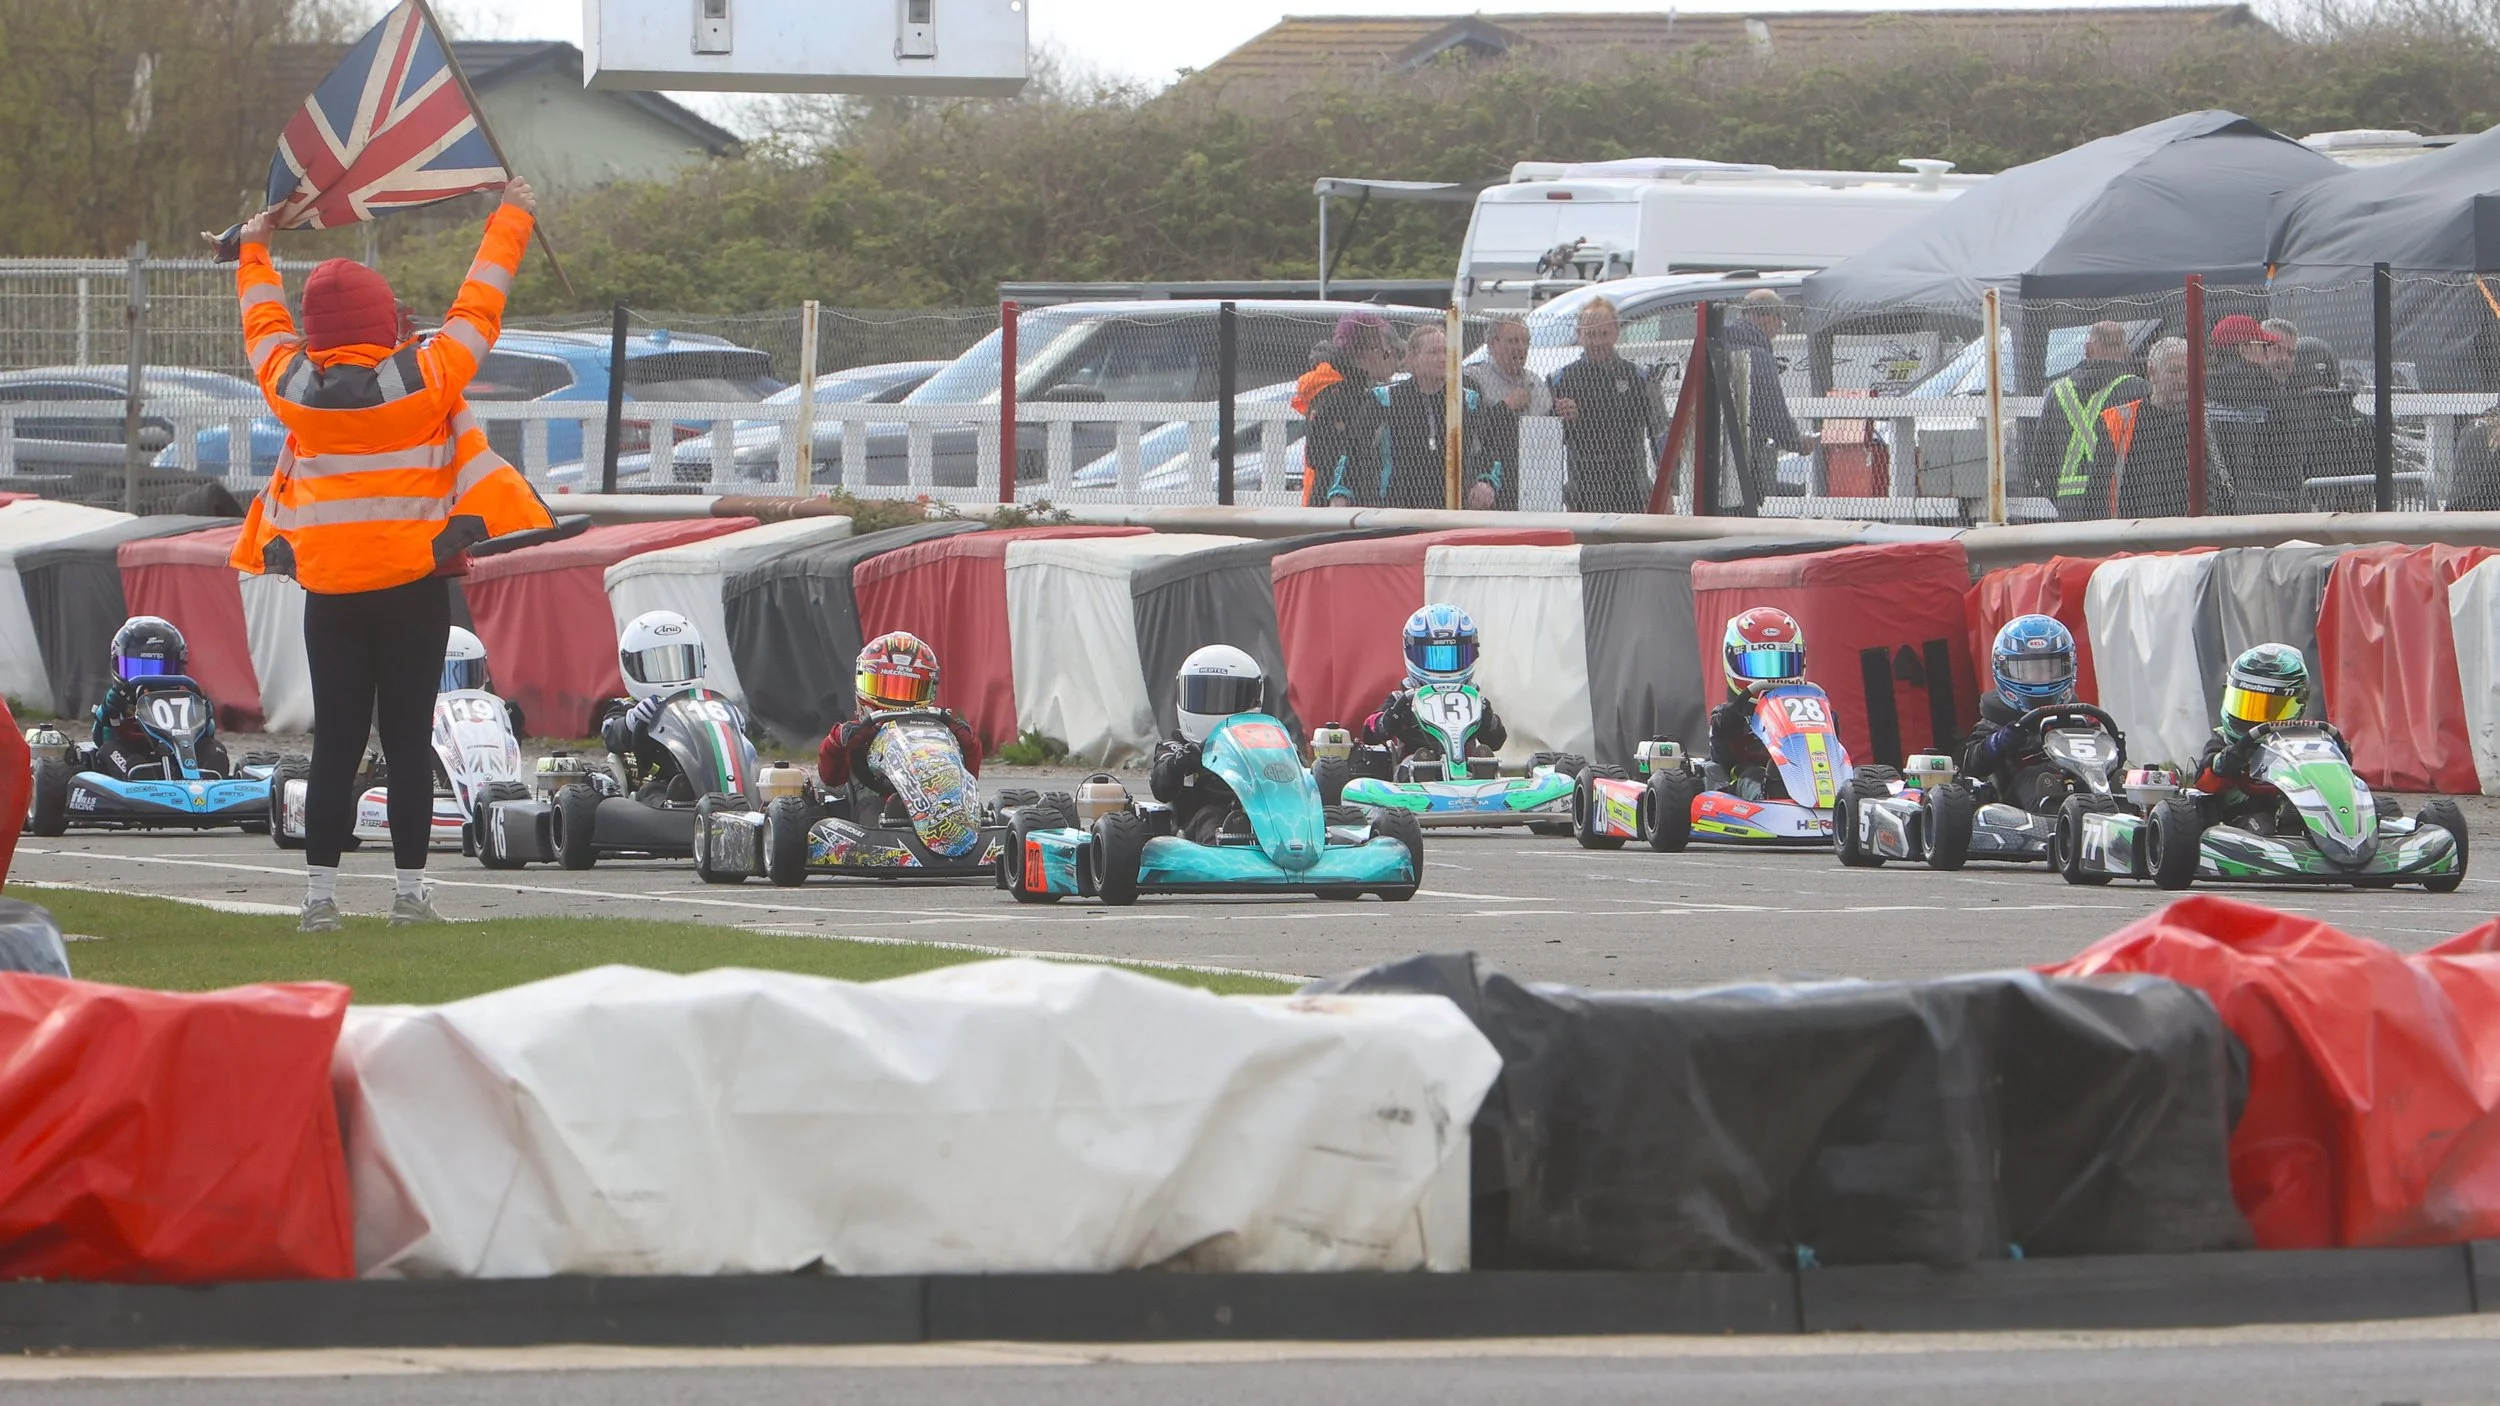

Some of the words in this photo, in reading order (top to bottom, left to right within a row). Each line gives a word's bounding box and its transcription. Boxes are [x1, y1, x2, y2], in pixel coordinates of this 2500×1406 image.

[1751, 643, 1776, 651] LKQ
[2239, 681, 2276, 693] Reuben
[2283, 688, 2296, 696] 77
[152, 697, 191, 730] 07
[452, 699, 496, 721] 19
[686, 700, 731, 721] 16
[1423, 692, 1473, 725] 13
[1784, 698, 1826, 722] 28
[2069, 738, 2097, 758] 5
[69, 803, 95, 811] RACING
[1595, 785, 1608, 833] 28
[490, 806, 507, 859] 16
[1859, 802, 1872, 843] 5
[2082, 822, 2102, 861] 77
[1028, 848, 1041, 888] 20
